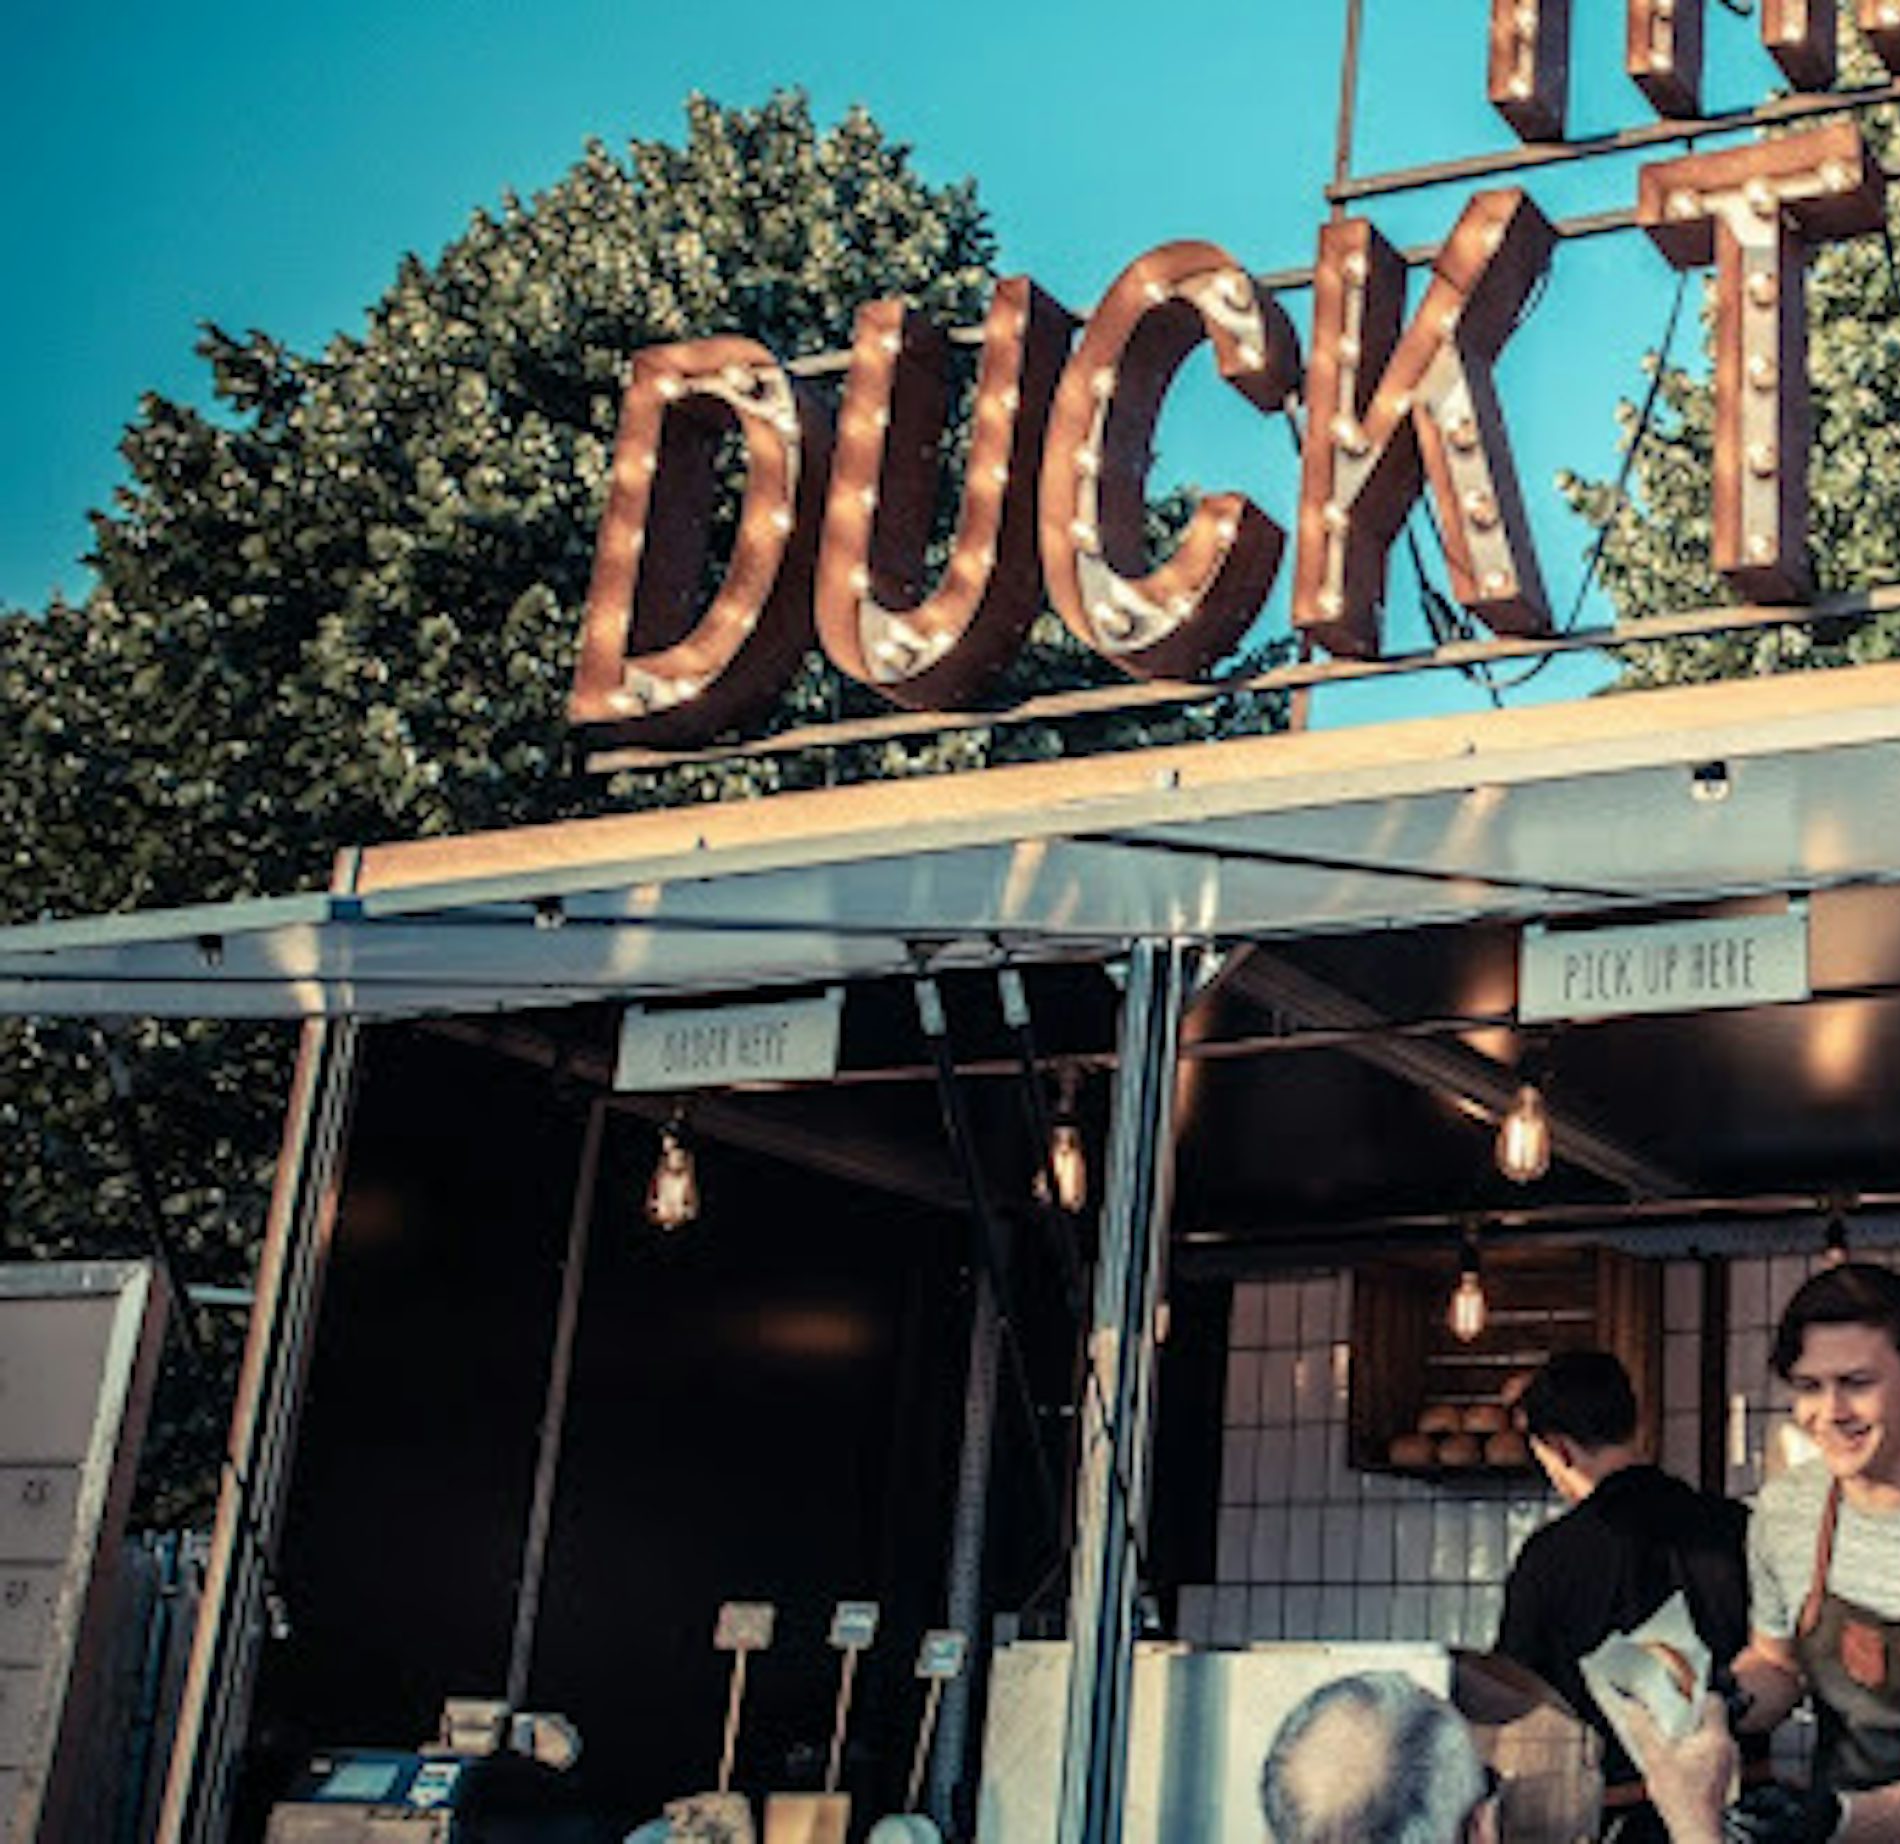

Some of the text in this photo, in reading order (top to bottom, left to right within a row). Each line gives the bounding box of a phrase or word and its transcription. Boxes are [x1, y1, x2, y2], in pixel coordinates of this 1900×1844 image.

[566, 188, 1562, 742] DUCK
[1563, 938, 1757, 1000] PICK UP HERE
